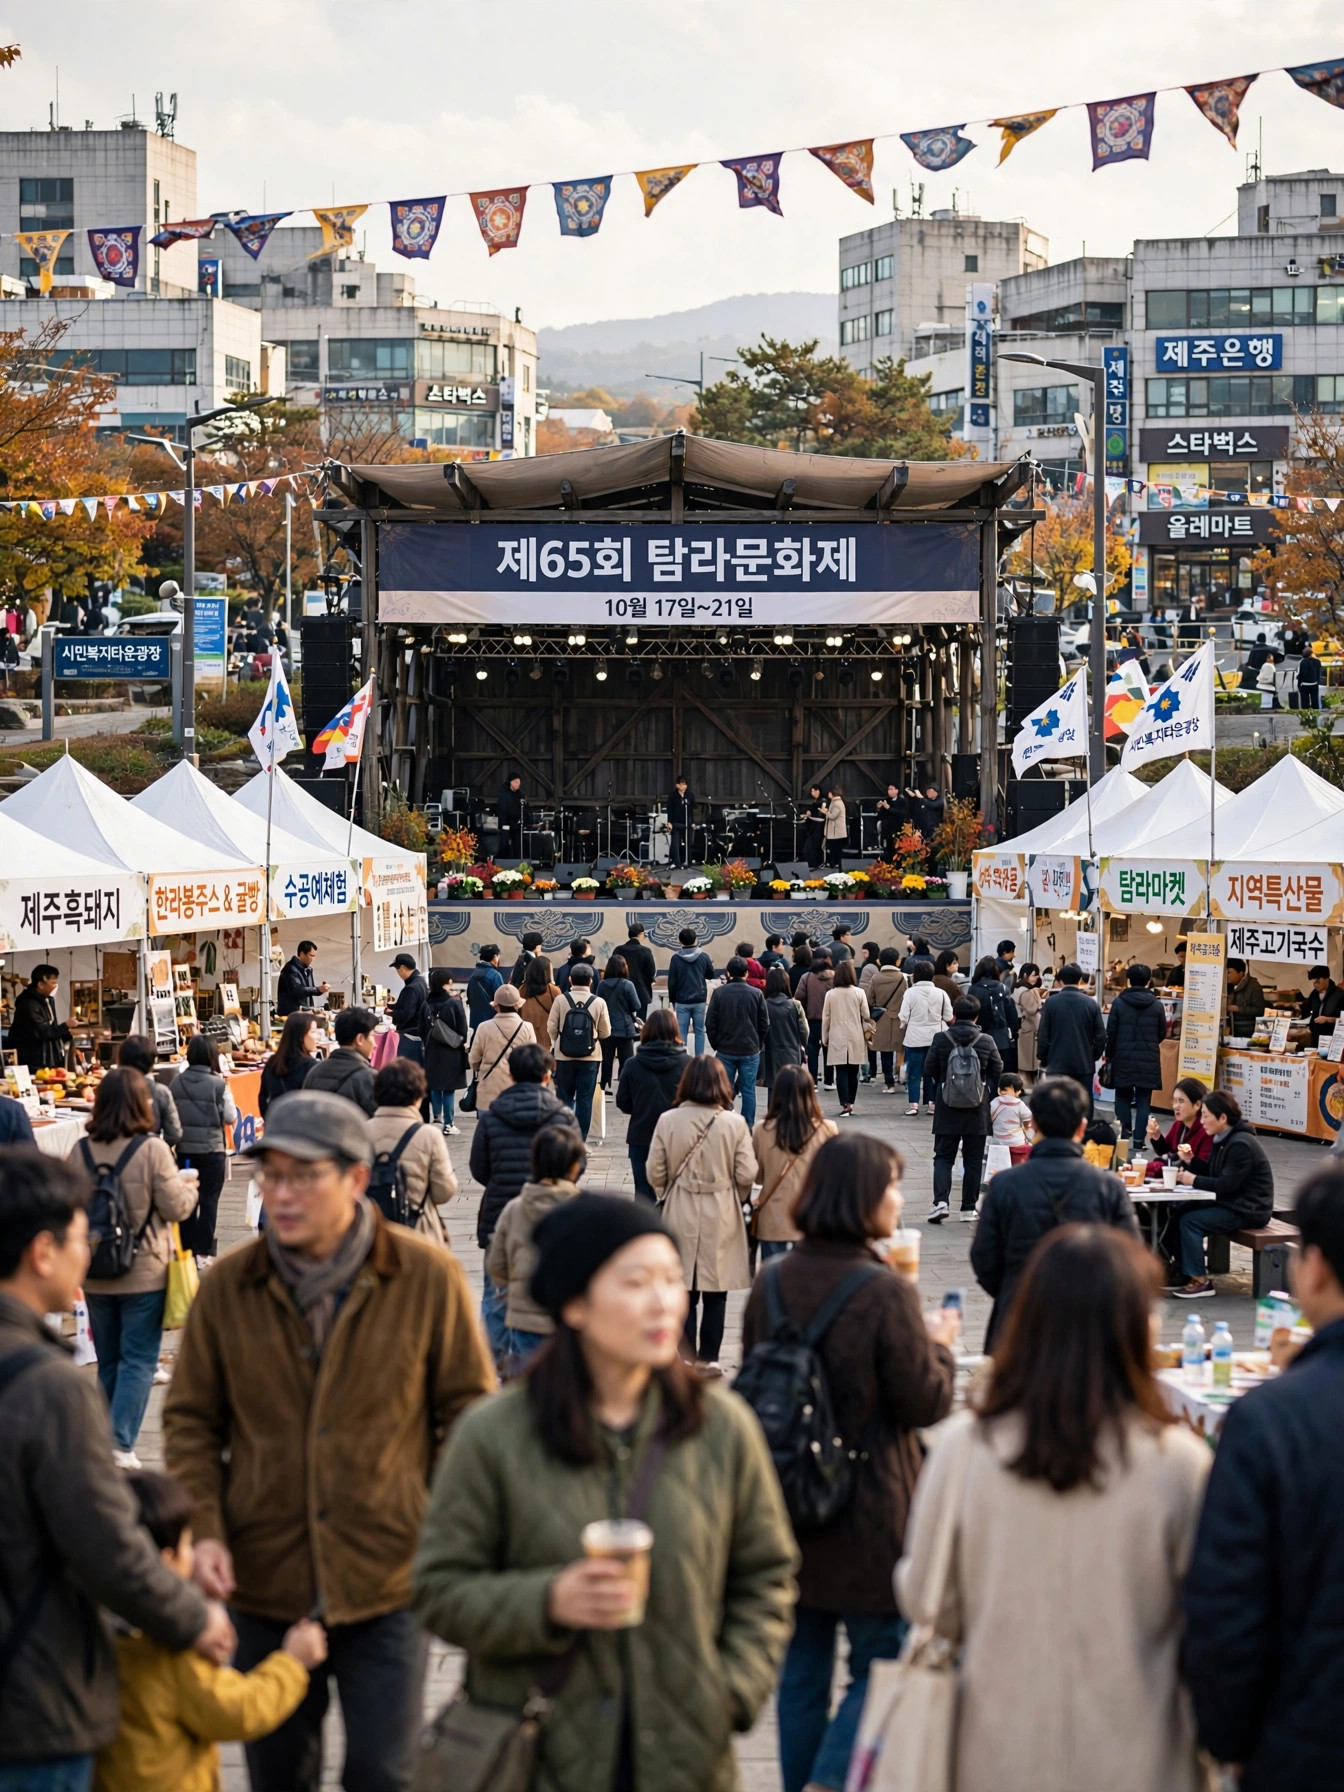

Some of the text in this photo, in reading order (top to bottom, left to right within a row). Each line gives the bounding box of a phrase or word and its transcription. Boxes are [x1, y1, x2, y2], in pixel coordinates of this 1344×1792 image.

[1162, 338, 1274, 368] 제주은행
[1167, 431, 1258, 456] 스타벅스
[1167, 515, 1254, 538] 올레마트
[496, 536, 857, 582] 제65회 탐라문화제
[604, 597, 754, 618] 10월 17일~21일
[62, 644, 162, 662] 시민복지타운광장
[155, 883, 221, 920] 한라봉주스
[223, 884, 233, 912] &
[284, 870, 347, 908] 수공예체험
[1118, 869, 1186, 906] 탐라마켓
[1227, 874, 1324, 913] 지역특산물
[20, 887, 121, 936] 제주흑돼지
[1230, 926, 1325, 961] 제주고기국수
